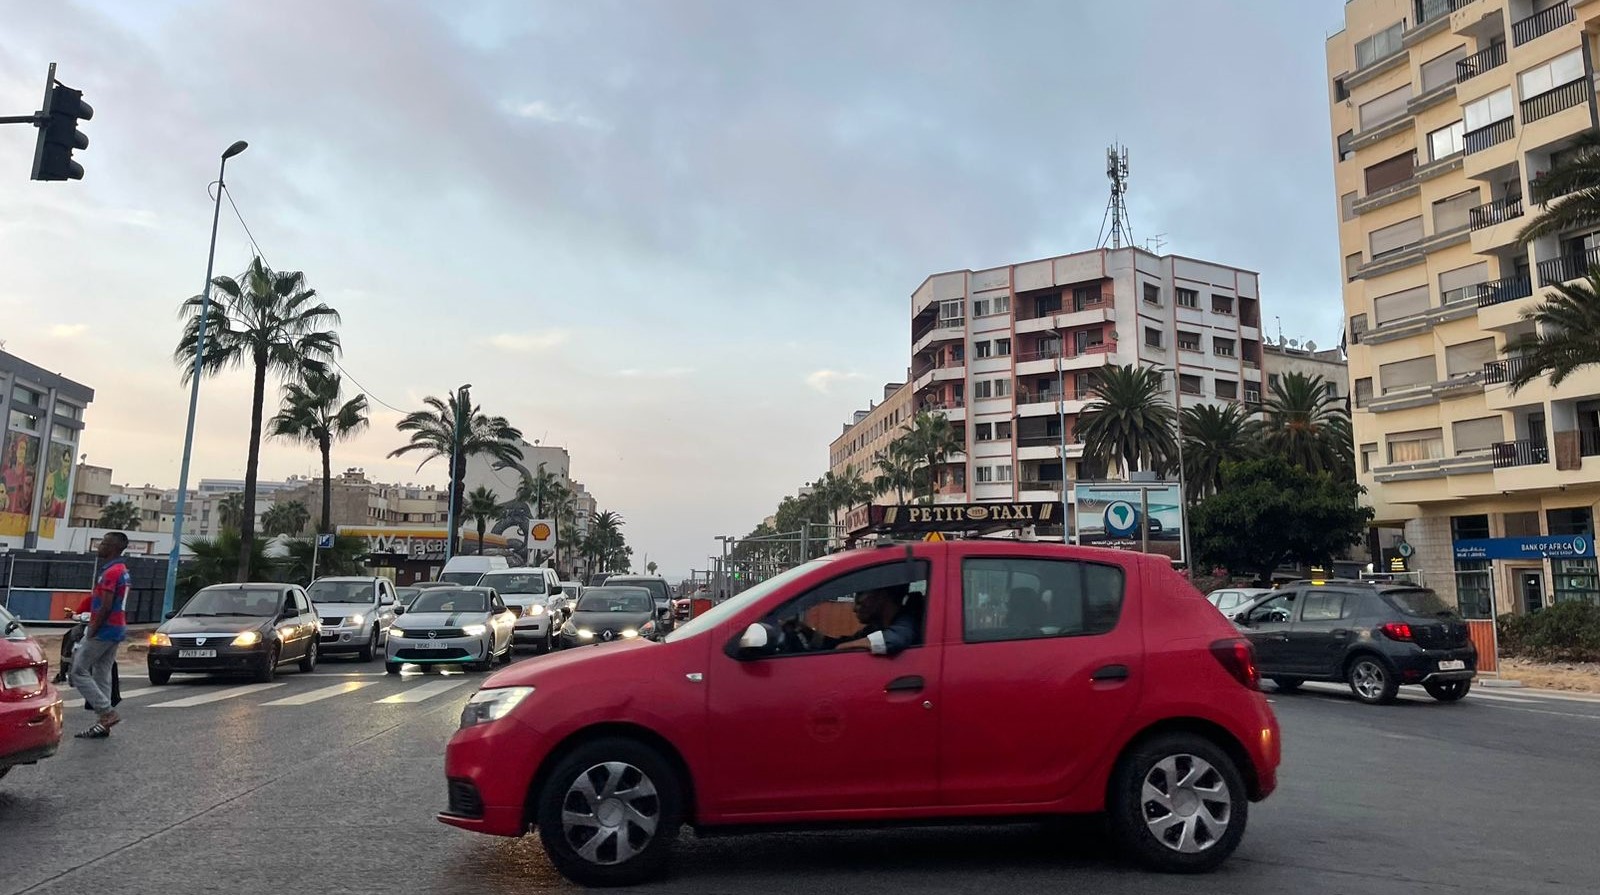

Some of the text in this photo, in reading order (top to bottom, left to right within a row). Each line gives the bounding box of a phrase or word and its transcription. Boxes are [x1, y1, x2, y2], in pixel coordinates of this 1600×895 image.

[909, 507, 965, 522] PETIT
[990, 504, 1033, 520] TAXI
[1549, 542, 1572, 550] AFRCA
